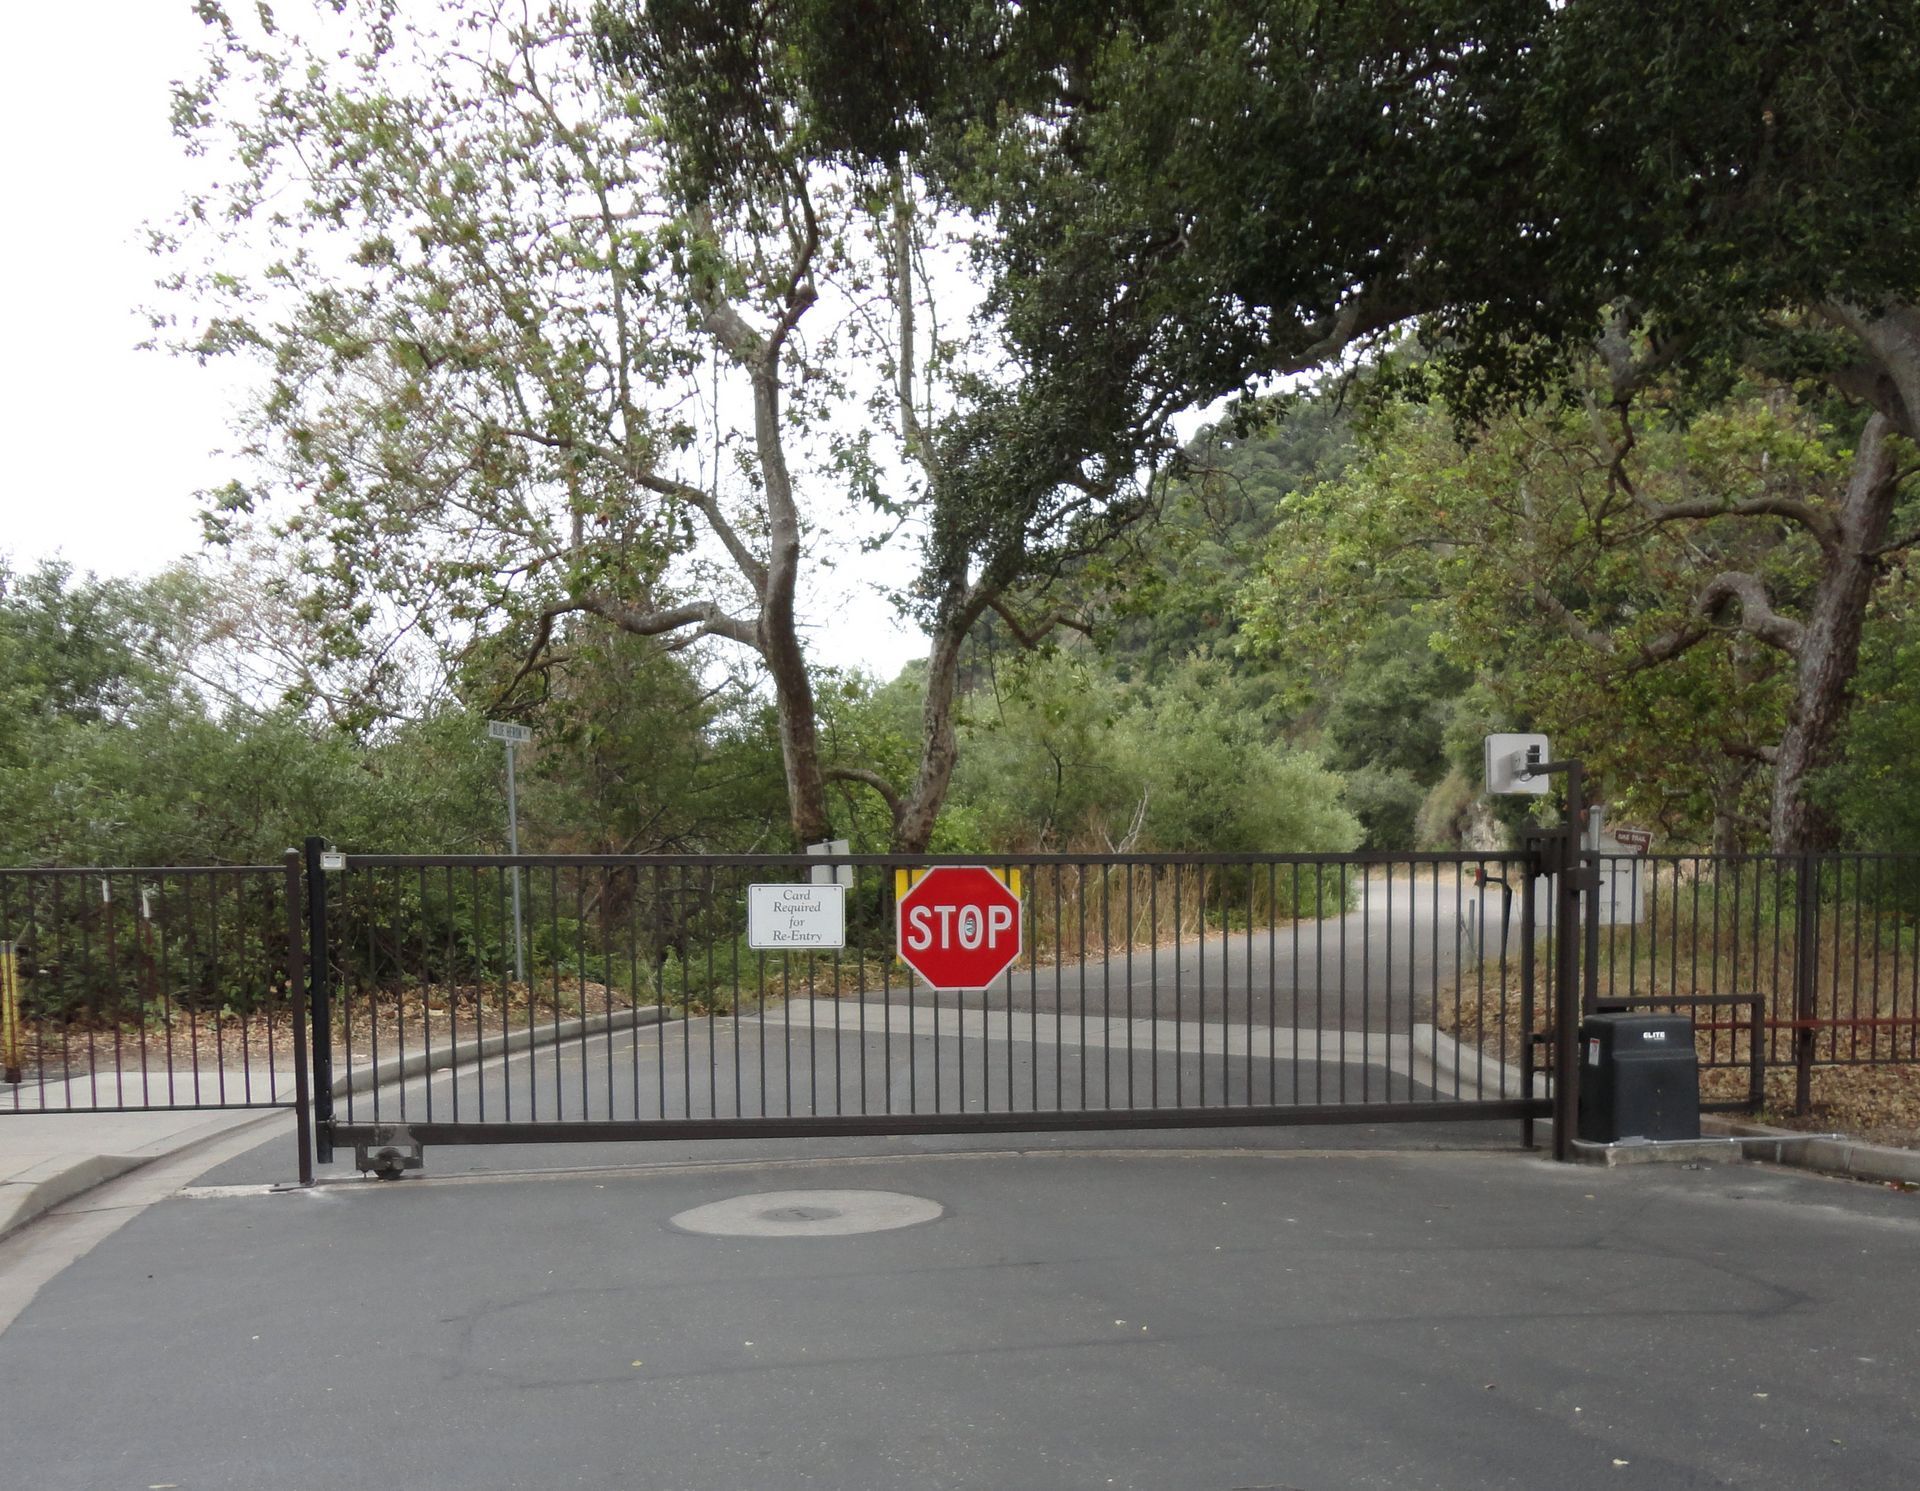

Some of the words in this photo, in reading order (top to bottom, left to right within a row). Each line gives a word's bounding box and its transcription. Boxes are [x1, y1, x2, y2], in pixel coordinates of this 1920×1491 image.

[783, 889, 811, 901] Card
[773, 901, 821, 914] Required
[789, 915, 806, 929] for
[907, 904, 1013, 950] STOP
[773, 930, 823, 943] Re-Entry
[1643, 1031, 1666, 1039] ELITE
